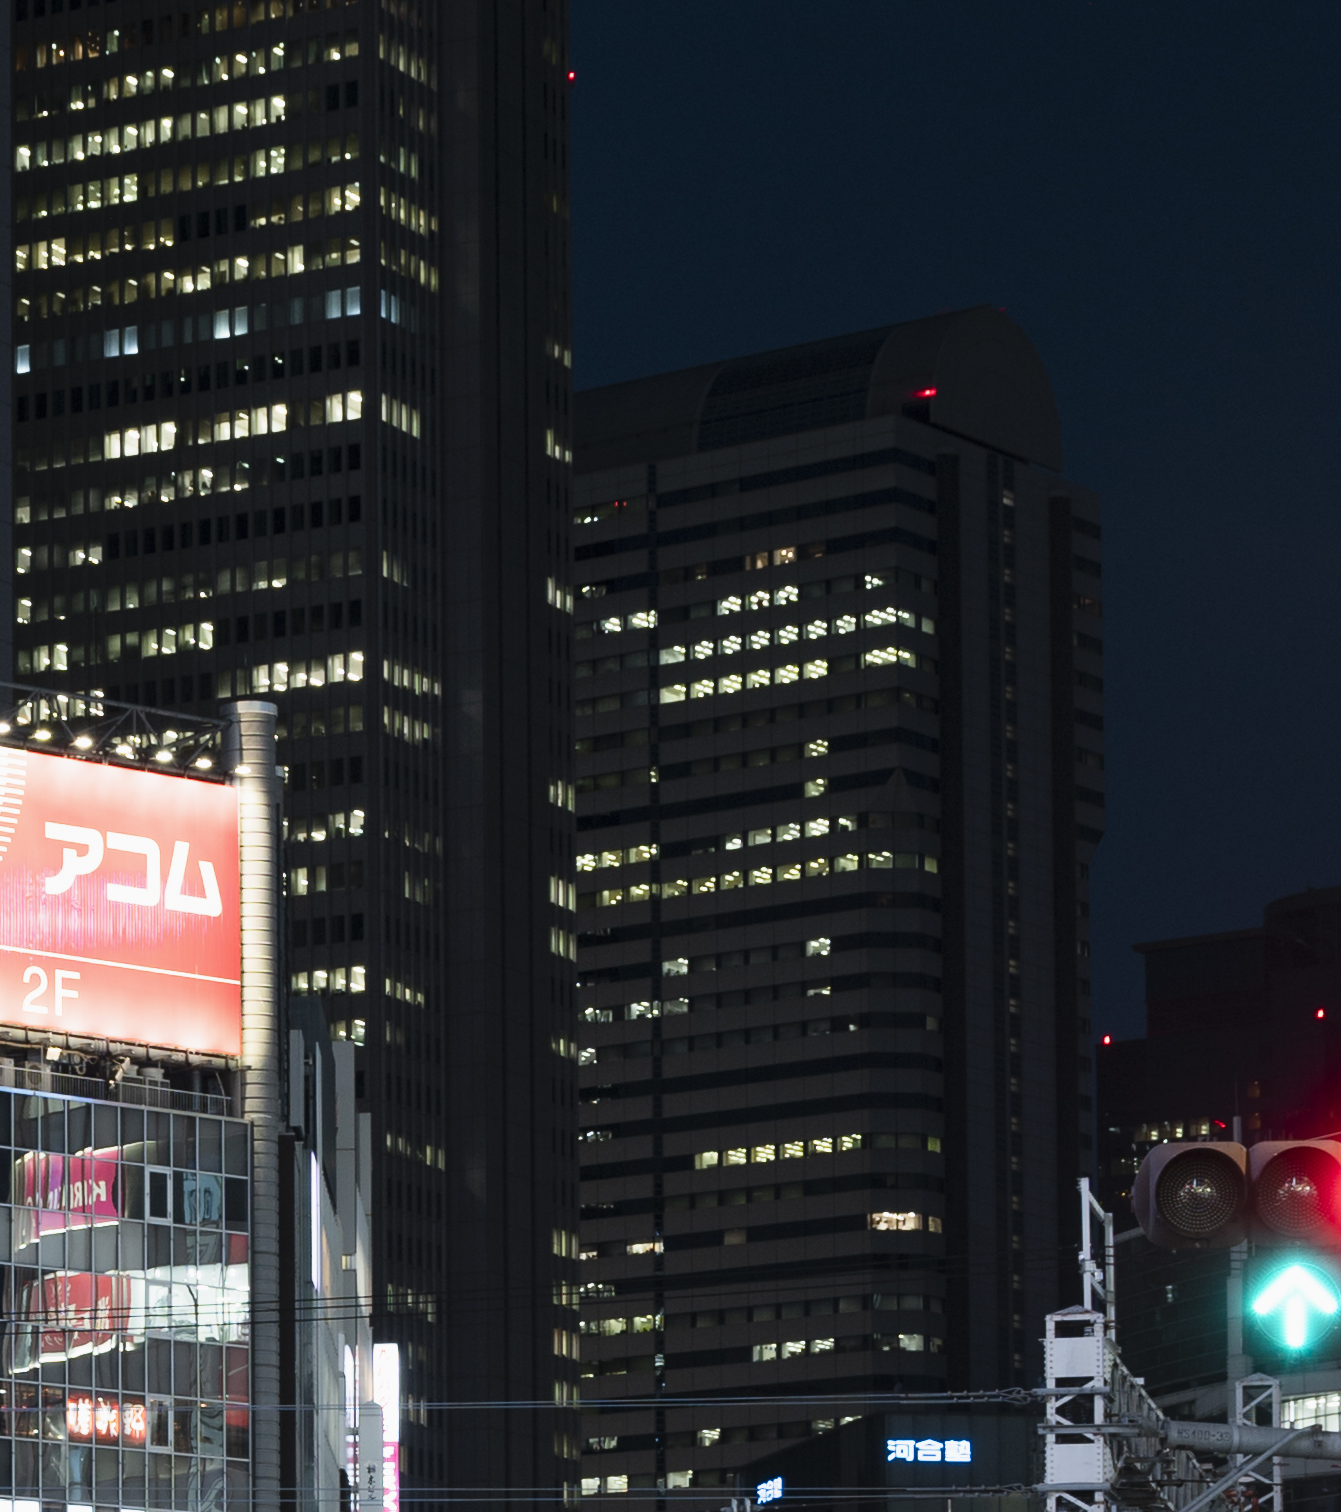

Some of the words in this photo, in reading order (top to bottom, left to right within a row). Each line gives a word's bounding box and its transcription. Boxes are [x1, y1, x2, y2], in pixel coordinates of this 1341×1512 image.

[44, 821, 223, 918] アコム
[22, 966, 81, 1017] 2F
[886, 1438, 972, 1463] 河合塾
